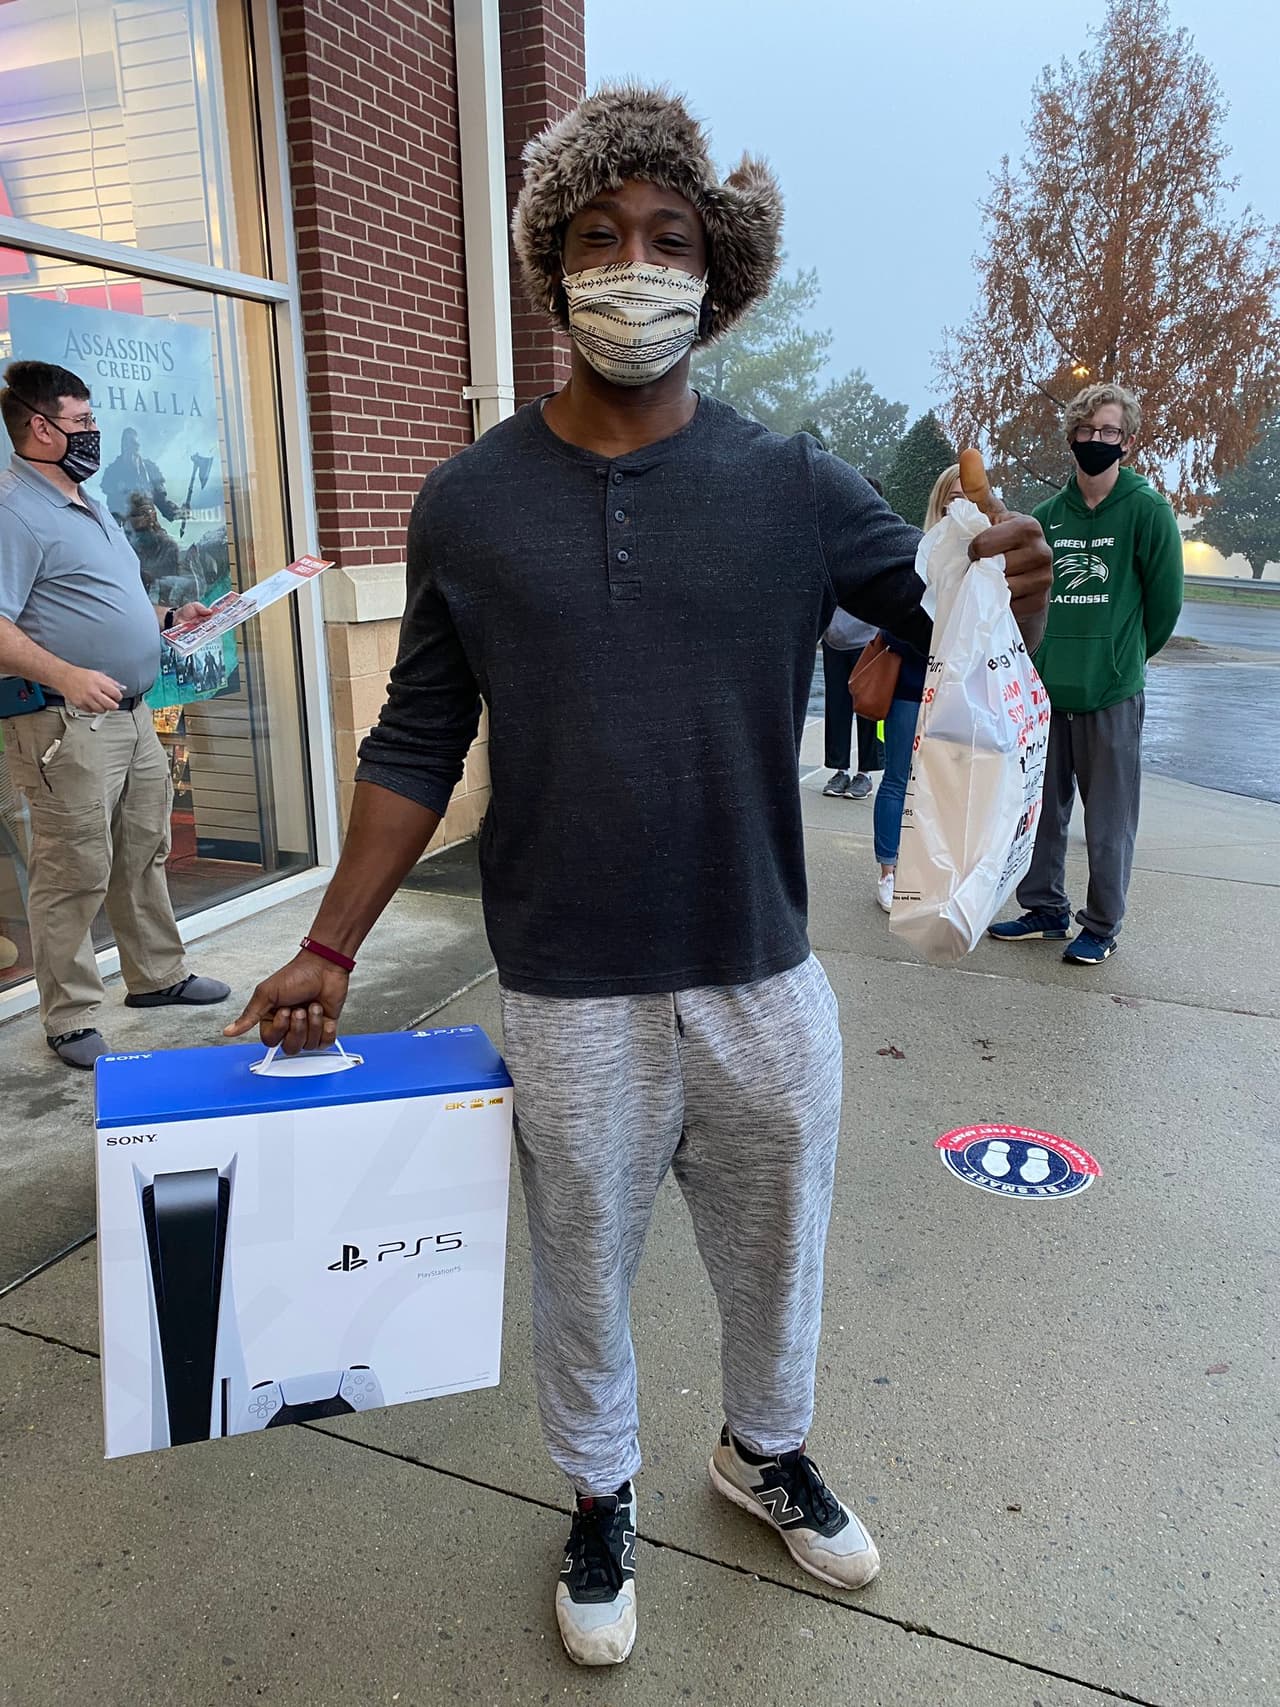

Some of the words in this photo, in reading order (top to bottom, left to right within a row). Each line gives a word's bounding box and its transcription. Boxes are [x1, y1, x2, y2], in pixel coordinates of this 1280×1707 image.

[64, 328, 174, 372] ASSASSIN'S
[97, 359, 152, 382] CREED
[87, 384, 202, 417] LHALLA
[1049, 593, 1109, 604] ACROSSE
[433, 1027, 474, 1036] PS5
[104, 1053, 153, 1062] SONY
[106, 1133, 157, 1147] SONY
[1020, 1130, 1057, 1145] STAND
[966, 1170, 1027, 1194] SMART
[1038, 1184, 1060, 1194] BE
[378, 1231, 463, 1262] PS5
